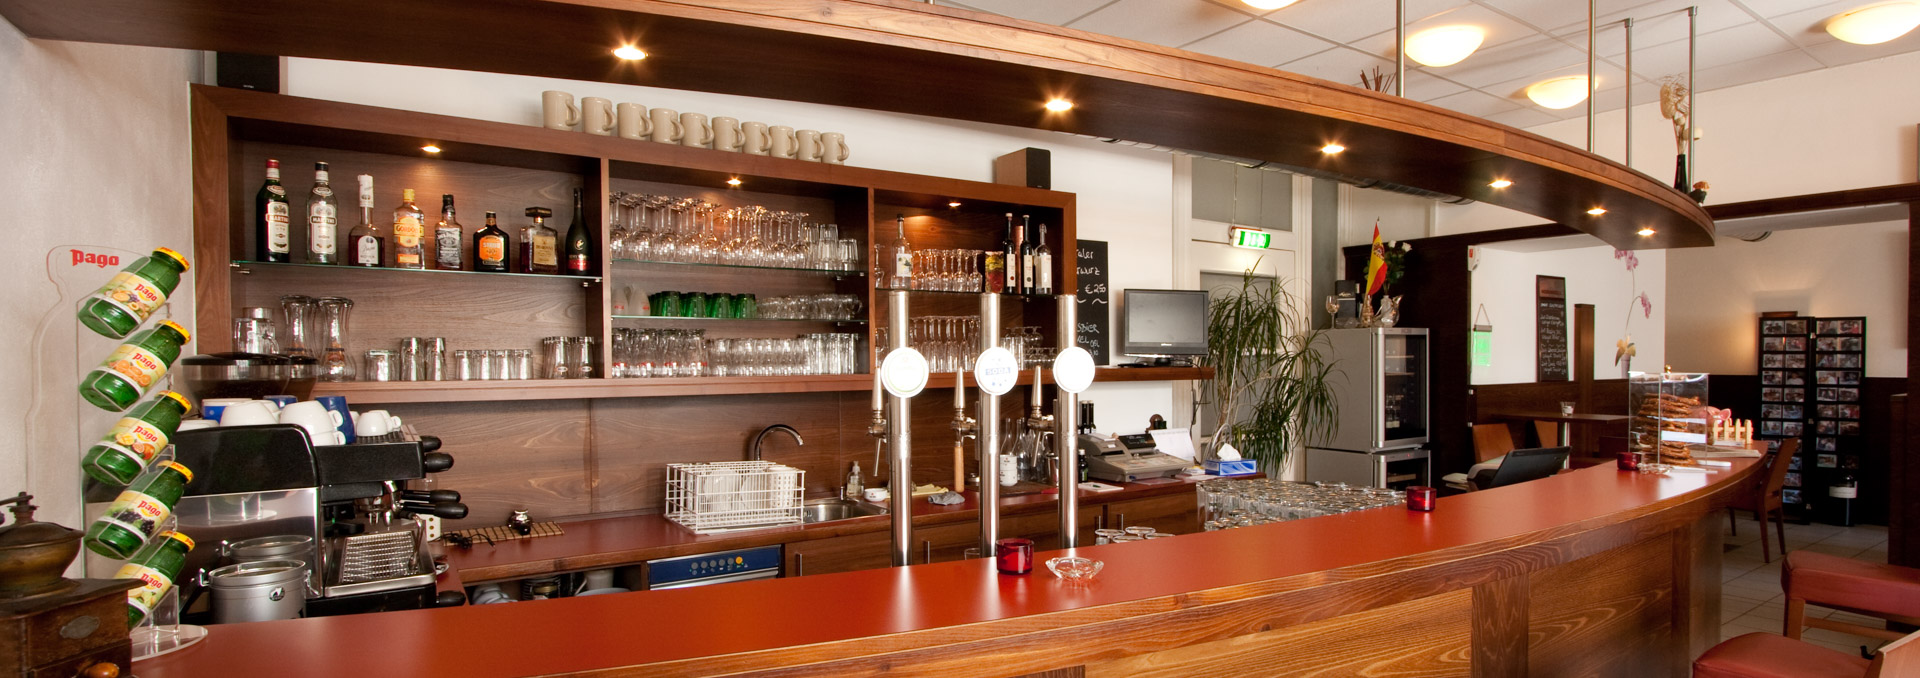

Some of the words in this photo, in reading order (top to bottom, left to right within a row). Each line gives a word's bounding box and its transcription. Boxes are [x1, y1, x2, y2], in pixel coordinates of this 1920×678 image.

[70, 249, 119, 268] pago
[134, 283, 158, 302] pago
[132, 352, 157, 371] pago
[133, 425, 158, 443] pago
[137, 500, 161, 517] pago
